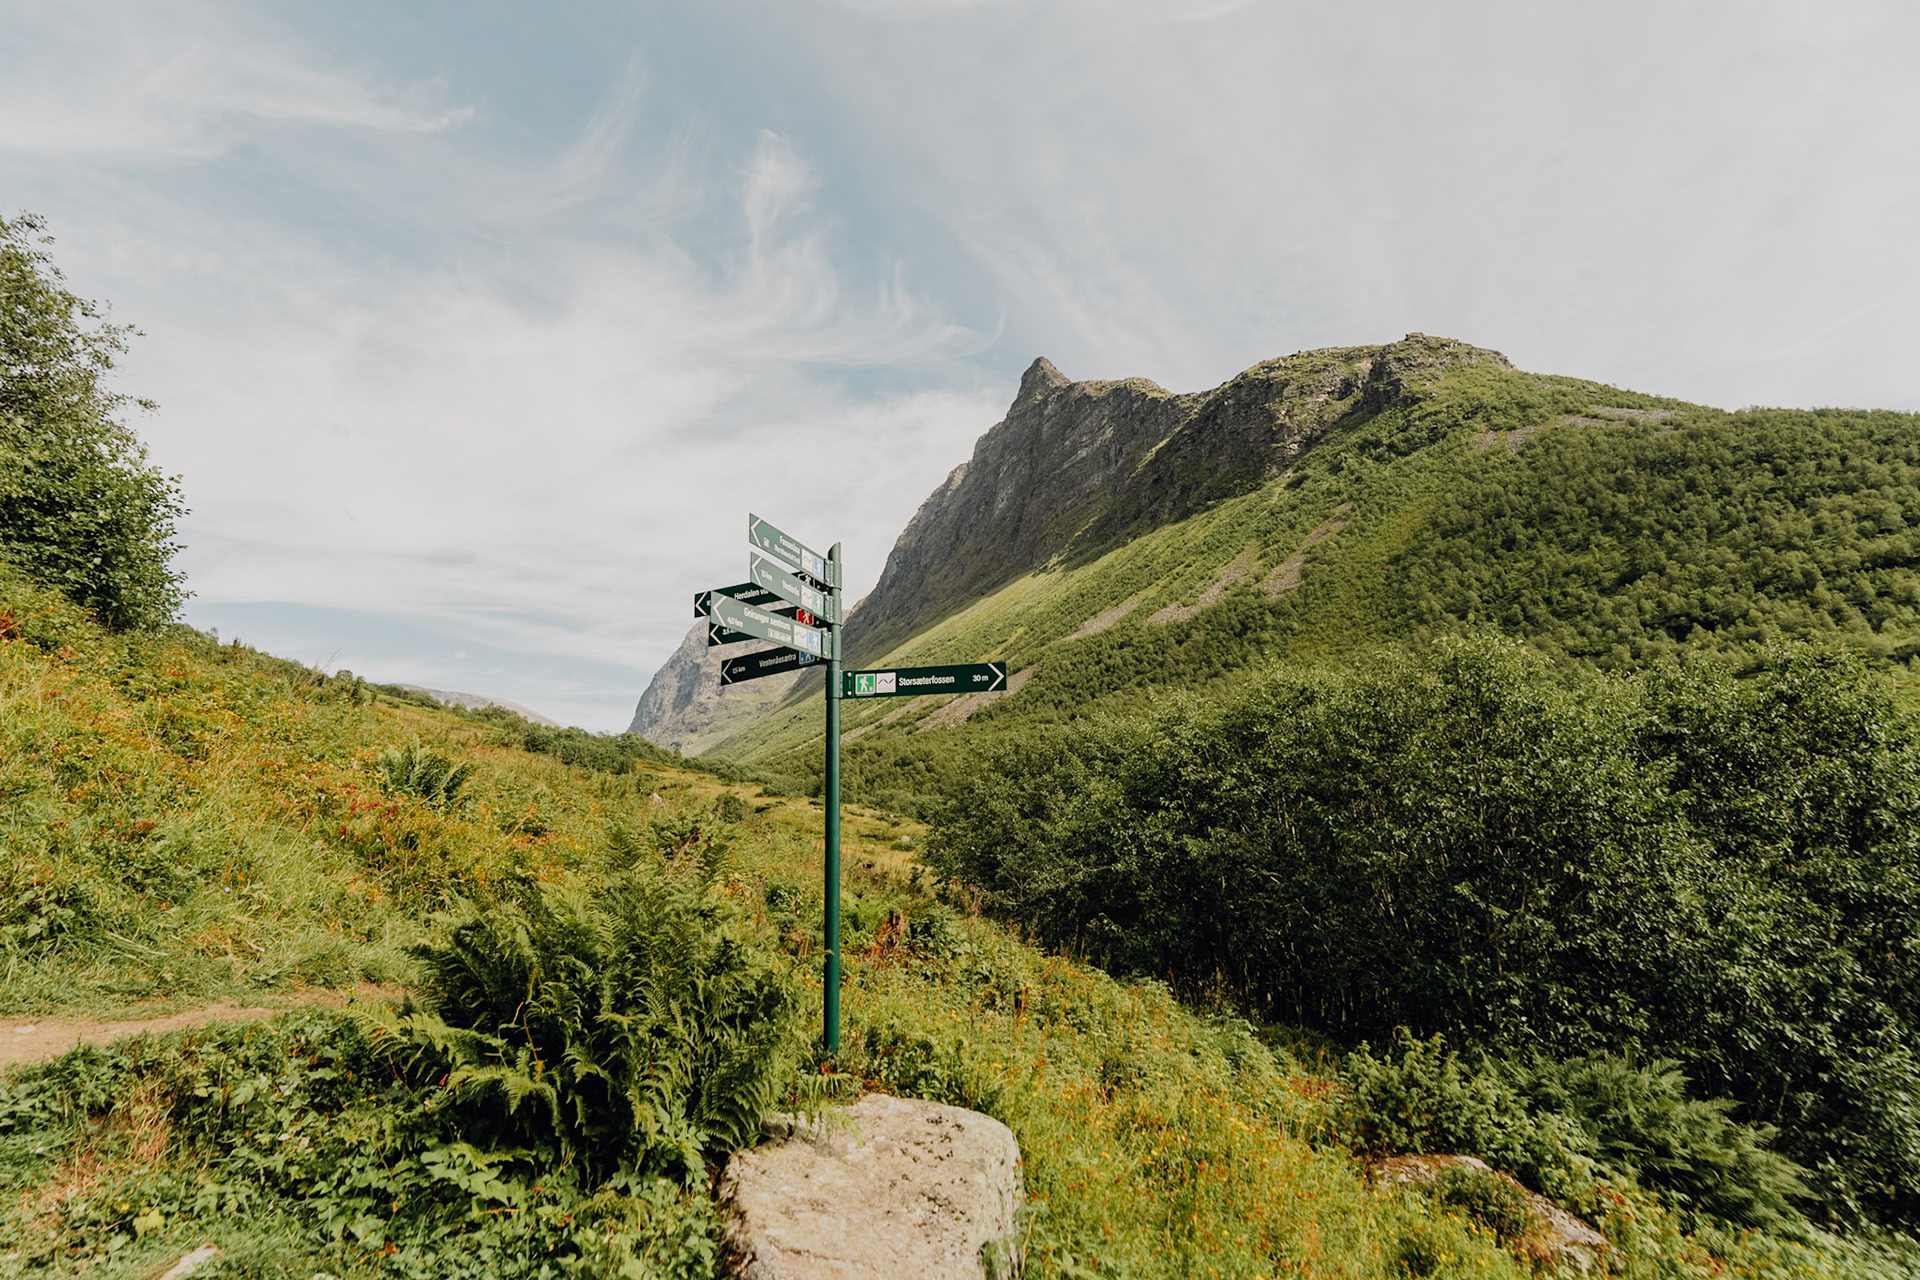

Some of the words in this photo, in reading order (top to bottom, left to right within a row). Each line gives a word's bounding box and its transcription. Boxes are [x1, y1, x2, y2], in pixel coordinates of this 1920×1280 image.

[734, 589, 760, 600] Herdalen
[735, 619, 743, 628] km
[743, 607, 770, 624] Geiranger
[769, 618, 791, 631] sentrum
[759, 653, 797, 668] Vesteråssætra
[898, 674, 955, 686] Storsæterfossen
[972, 674, 981, 682] 30
